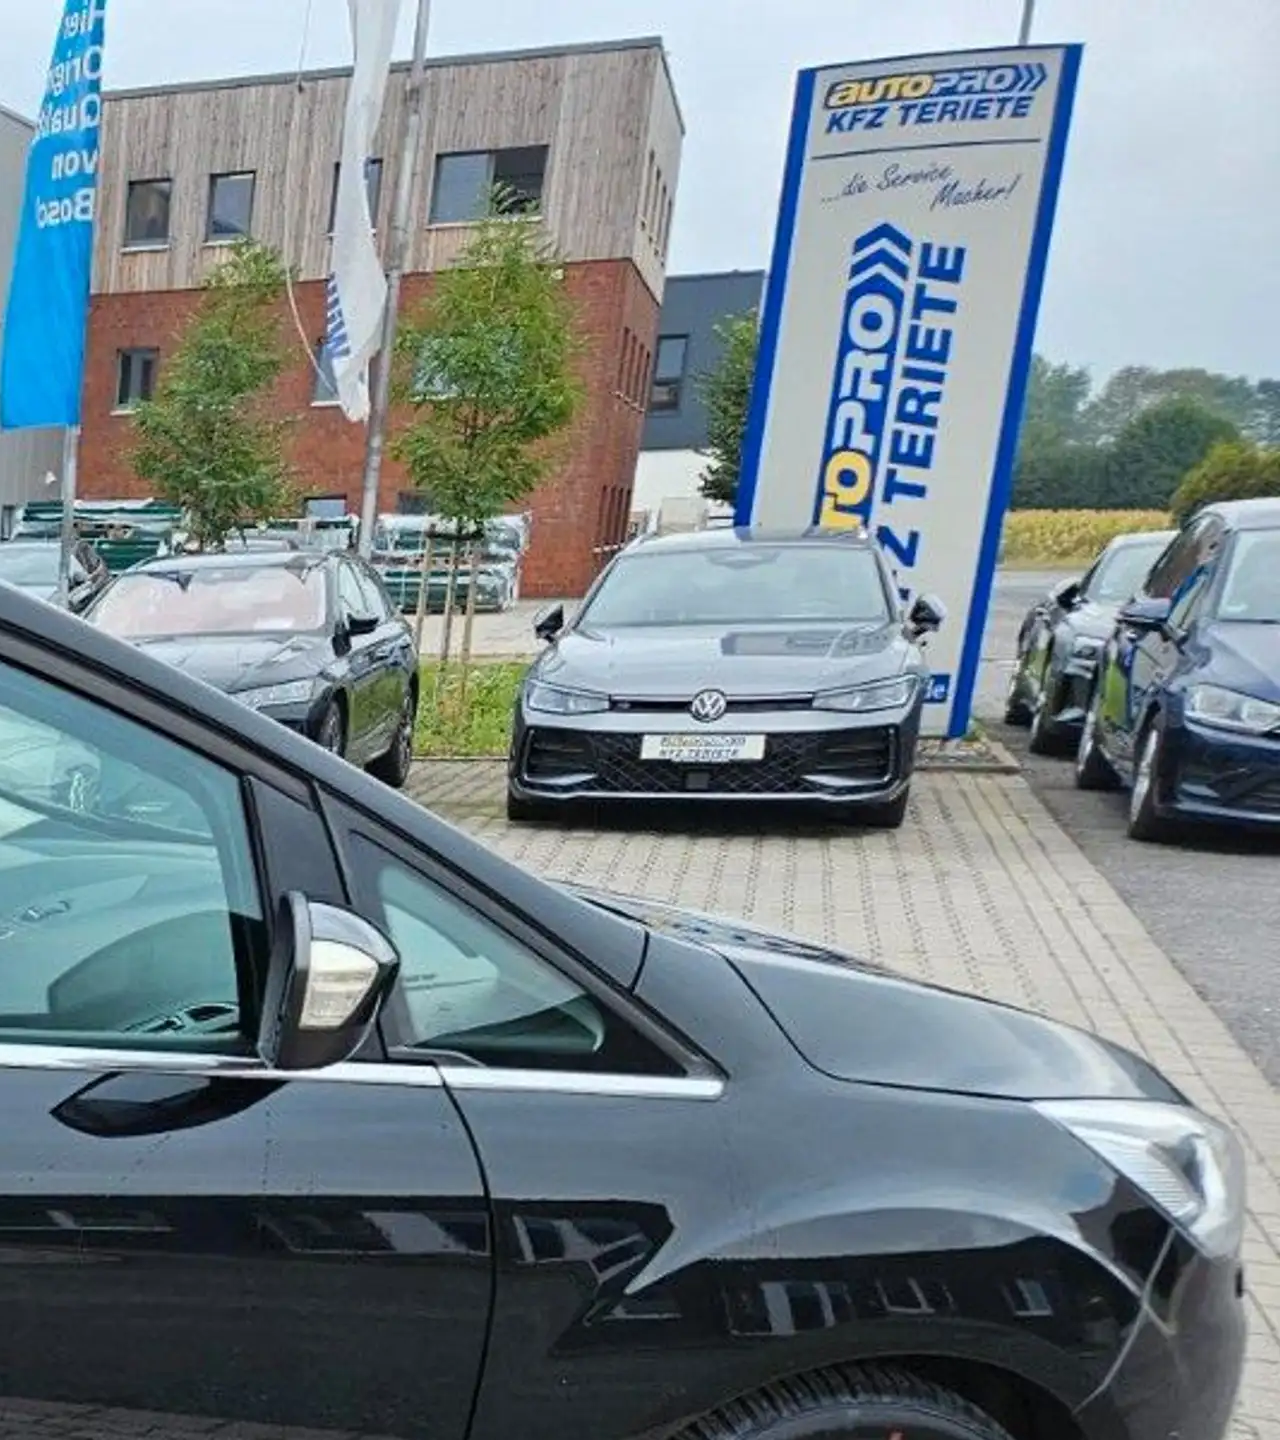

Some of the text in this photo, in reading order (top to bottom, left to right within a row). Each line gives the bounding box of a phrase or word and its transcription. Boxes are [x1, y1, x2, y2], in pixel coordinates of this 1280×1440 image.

[825, 96, 1034, 133] KFZ TERIETE
[878, 162, 953, 191] Service
[819, 292, 897, 528] TOPRO
[882, 242, 967, 504] TERIETE
